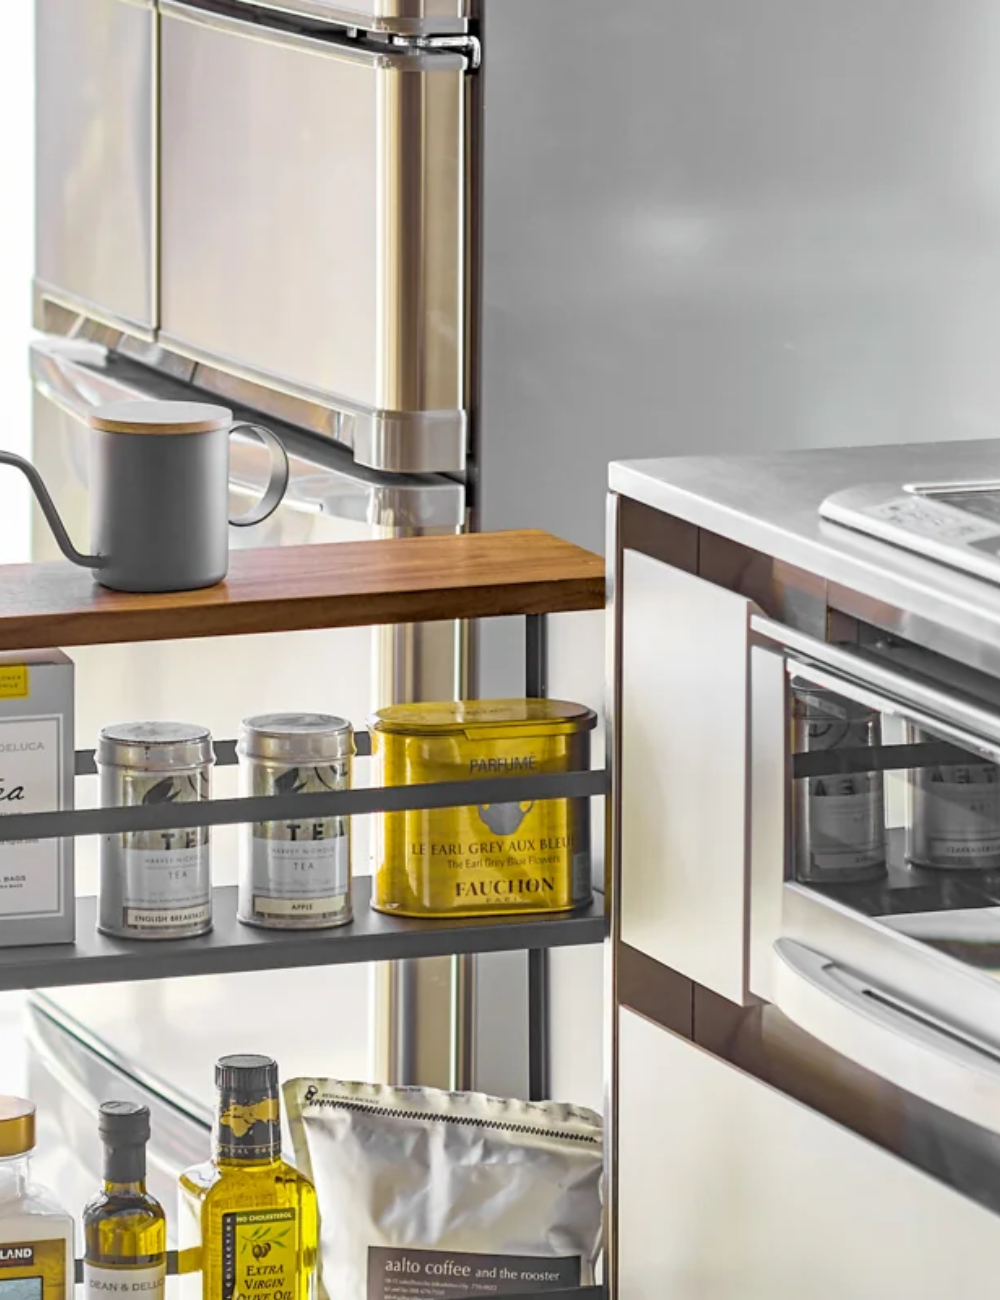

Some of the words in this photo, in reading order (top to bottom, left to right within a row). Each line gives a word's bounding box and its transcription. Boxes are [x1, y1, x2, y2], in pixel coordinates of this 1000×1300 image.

[411, 843, 426, 856] LE
[430, 843, 465, 856] EARL
[468, 841, 505, 854] GREY
[508, 839, 536, 853] AUX
[294, 862, 314, 870] TEA
[447, 859, 463, 869] The
[465, 859, 483, 869] Earl
[484, 858, 505, 871] Grey
[507, 856, 527, 867] Blue
[528, 854, 561, 866] Flowers
[3, 875, 26, 883] BAGS
[168, 870, 188, 880] TEA
[455, 877, 556, 897] FAUCHON
[291, 903, 313, 911] APPLE
[134, 914, 168, 923] ENGLISH
[246, 1264, 285, 1277] EXTRA
[384, 1257, 421, 1273] aalto
[424, 1260, 472, 1277] coffee
[475, 1267, 497, 1279] and
[499, 1268, 518, 1280] the
[520, 1270, 561, 1282] rooster
[120, 1282, 130, 1292] &
[244, 1278, 285, 1290] VIRGIN
